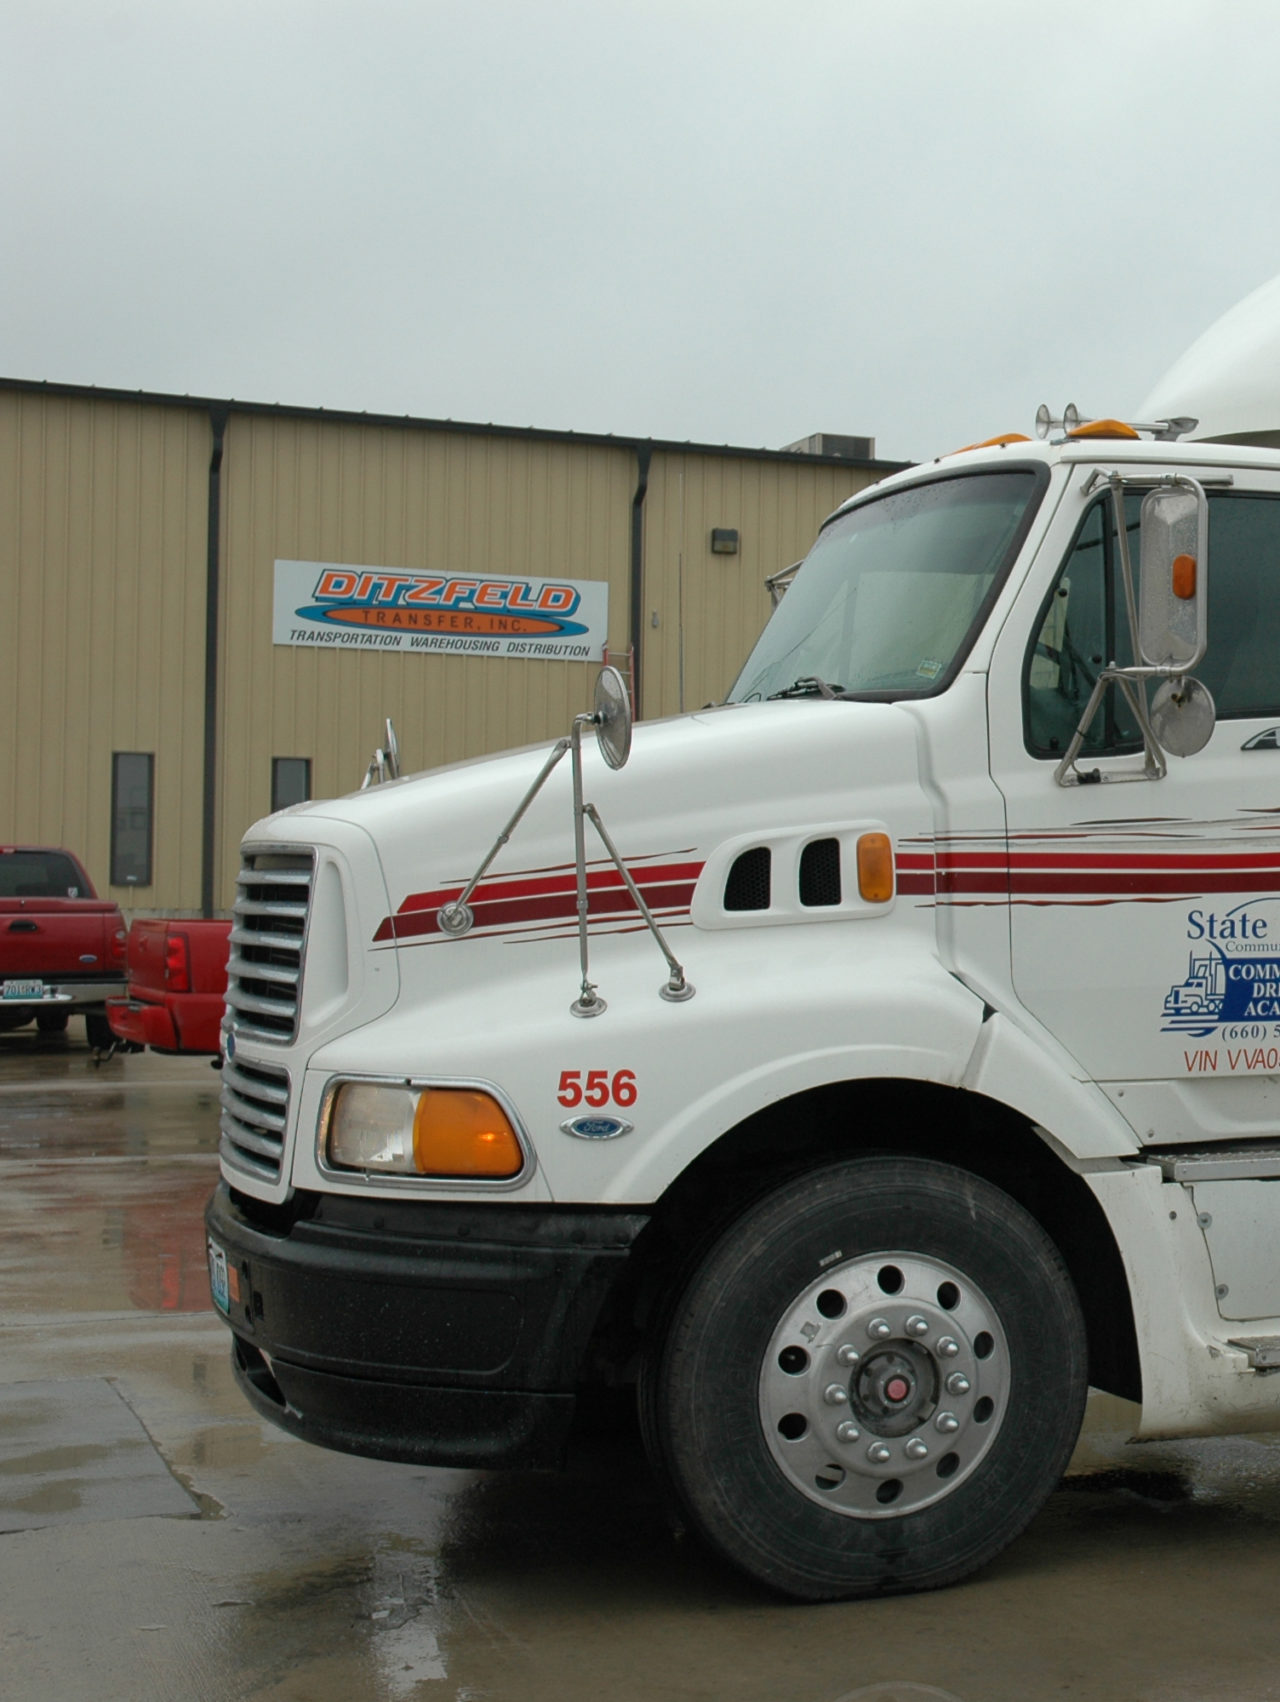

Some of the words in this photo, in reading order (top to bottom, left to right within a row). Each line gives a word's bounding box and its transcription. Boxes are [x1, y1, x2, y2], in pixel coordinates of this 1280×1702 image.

[313, 569, 580, 616] DITZFELD
[362, 610, 481, 631] TRANSFER,
[489, 618, 527, 632] INC.
[290, 630, 402, 647] TRANSPORTATION
[410, 636, 500, 652] WAREHOUSING
[506, 641, 590, 656] DISTRIBUTION
[1187, 910, 1267, 939] State
[1222, 1025, 1267, 1041] (660)
[1184, 1050, 1218, 1072] VIN
[557, 1069, 637, 1107] 556
[583, 1120, 610, 1132] Ford
